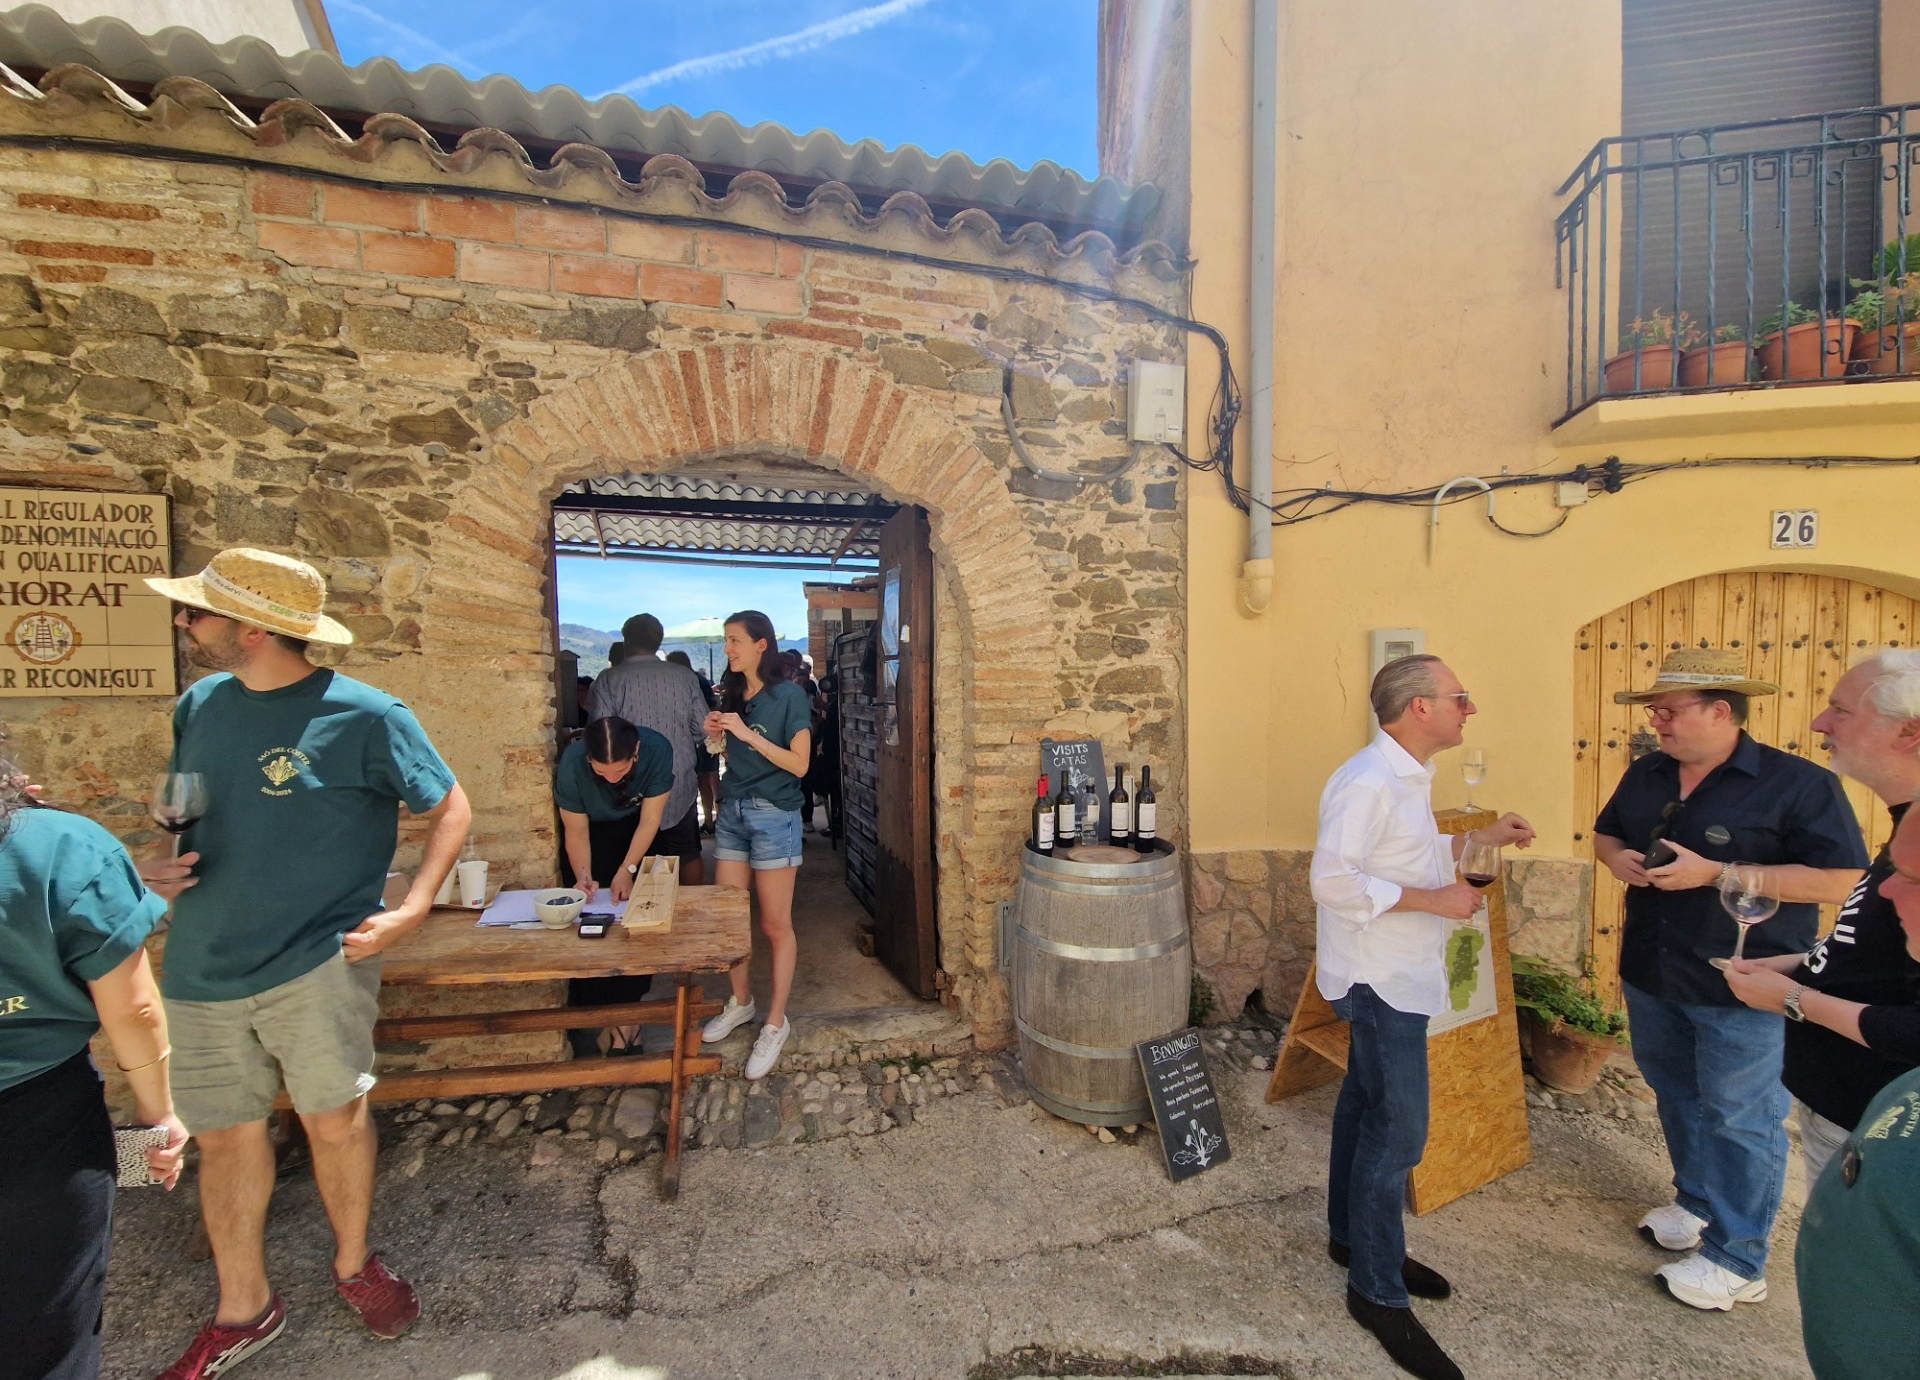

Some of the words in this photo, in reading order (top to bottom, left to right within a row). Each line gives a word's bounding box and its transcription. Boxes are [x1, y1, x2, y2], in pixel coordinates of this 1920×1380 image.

[24, 500, 154, 523] REGULADOR
[1, 525, 158, 550] DENOMINACIÓ
[1776, 514, 1815, 543] 26
[18, 551, 167, 574] QUALIFICADA
[0, 580, 128, 607] IORAT
[26, 668, 157, 689] RECONEGUT
[1052, 743, 1089, 756] VISITS
[1053, 755, 1087, 767] CATAS
